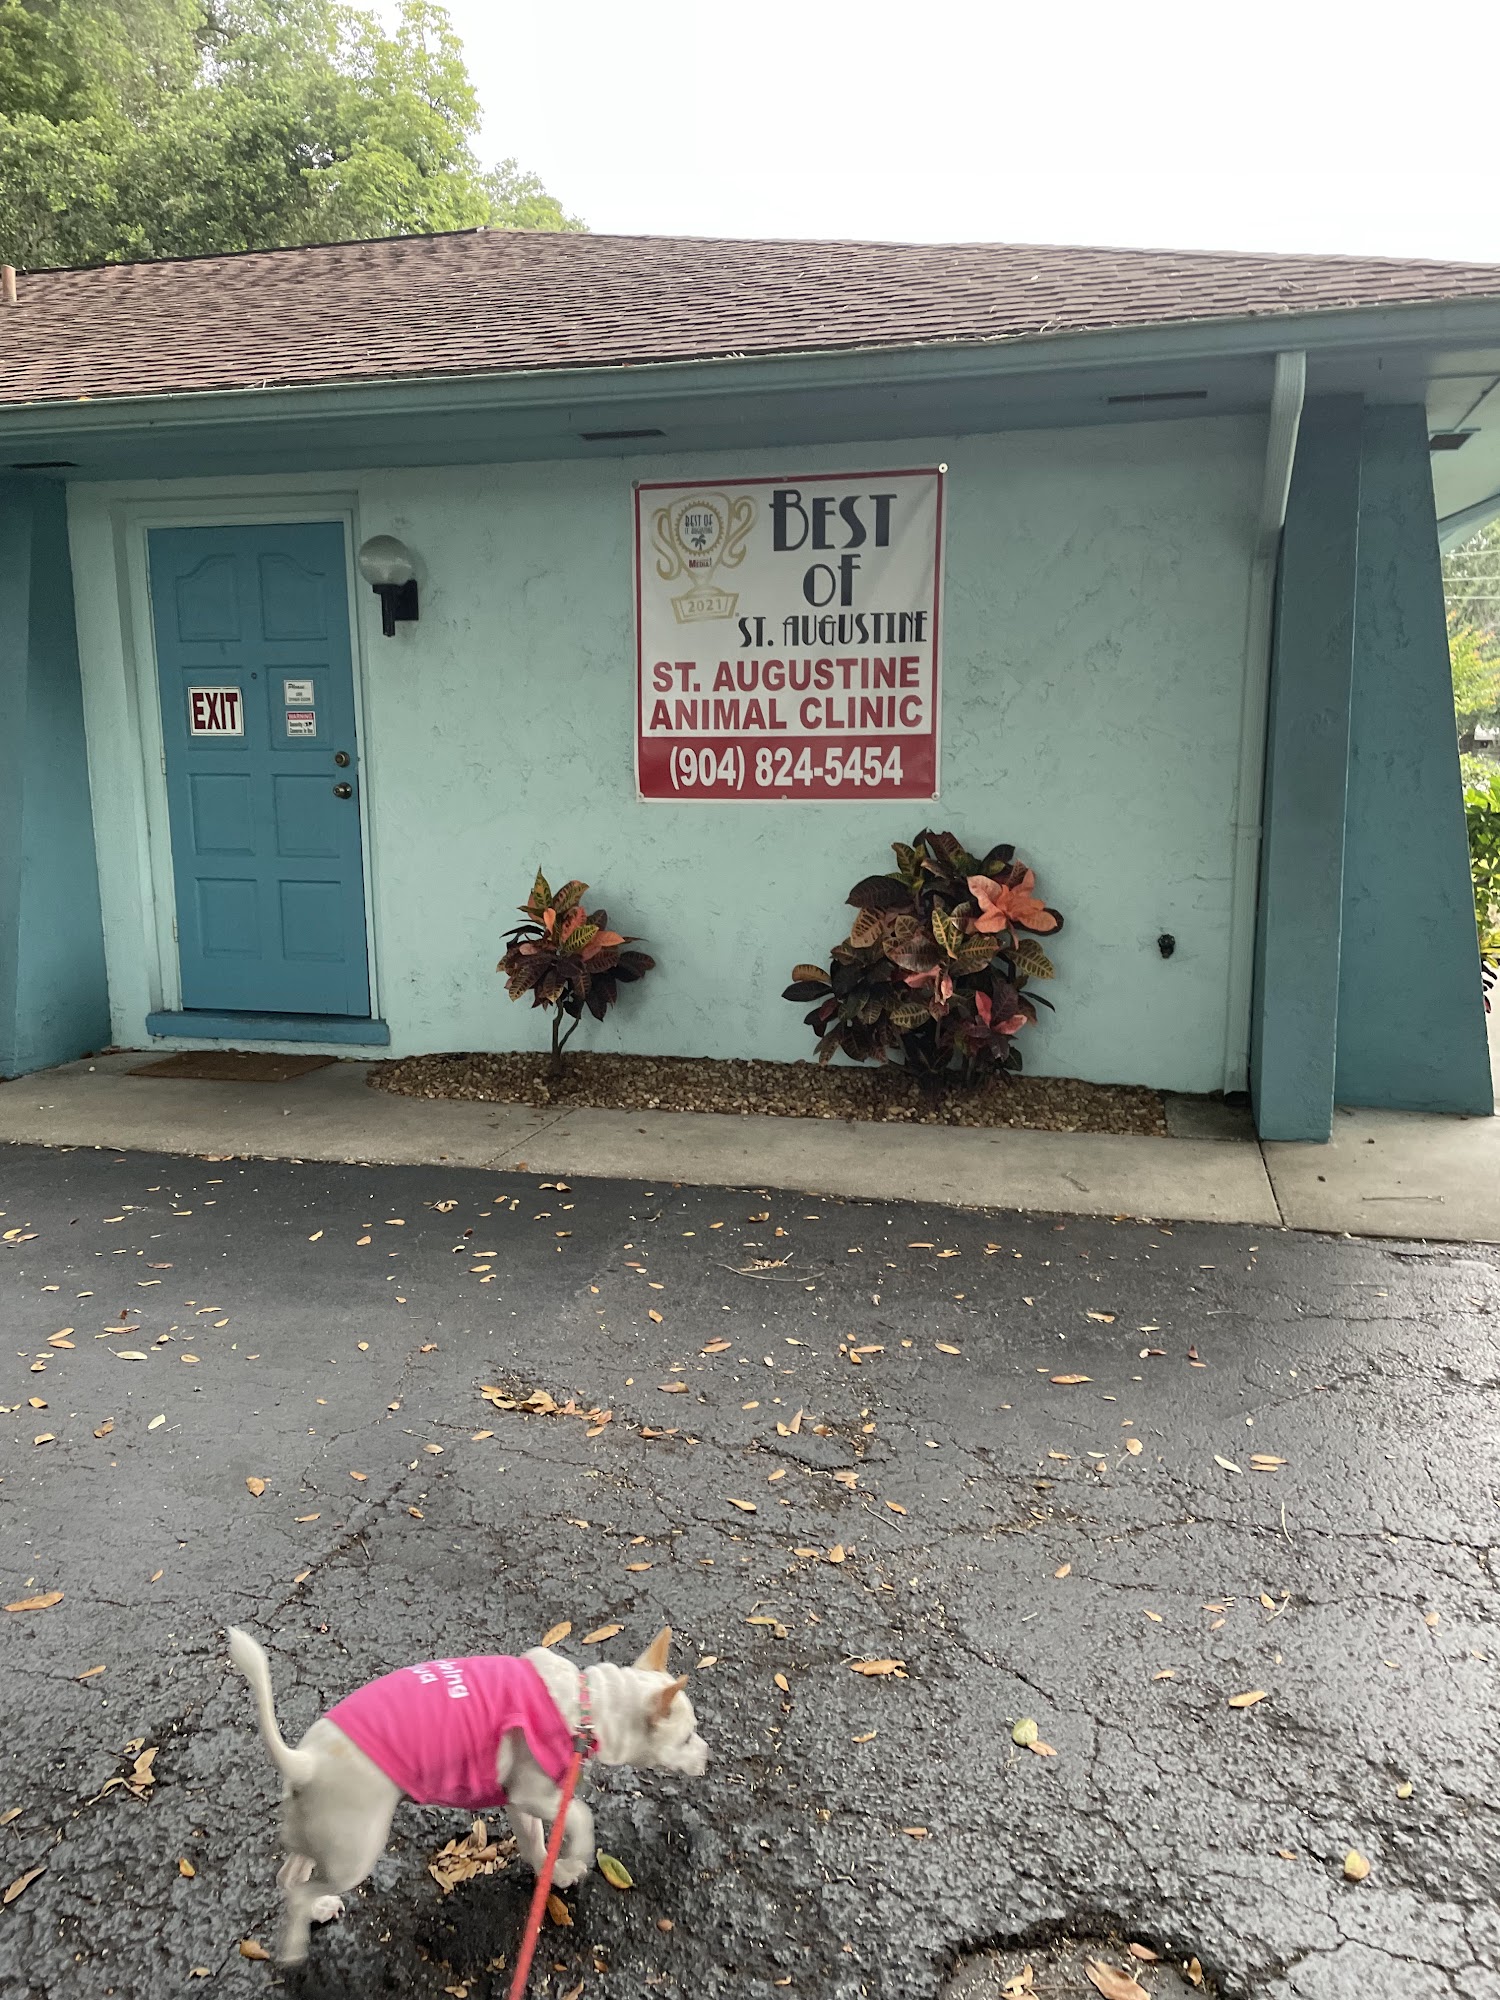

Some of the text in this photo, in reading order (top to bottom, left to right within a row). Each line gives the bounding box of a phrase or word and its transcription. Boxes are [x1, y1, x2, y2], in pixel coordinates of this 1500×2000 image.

[685, 514, 713, 527] BEST OF
[769, 489, 897, 551] BEST
[803, 553, 861, 607] OF
[688, 598, 721, 612] 2021
[738, 611, 927, 647] ST. AUGUSTINE
[652, 656, 920, 692] ST. AUGUSTINE
[192, 693, 238, 729] EXIT
[649, 695, 923, 730] ANIMAL CLINIC
[669, 746, 903, 790] (904) 824-5454
